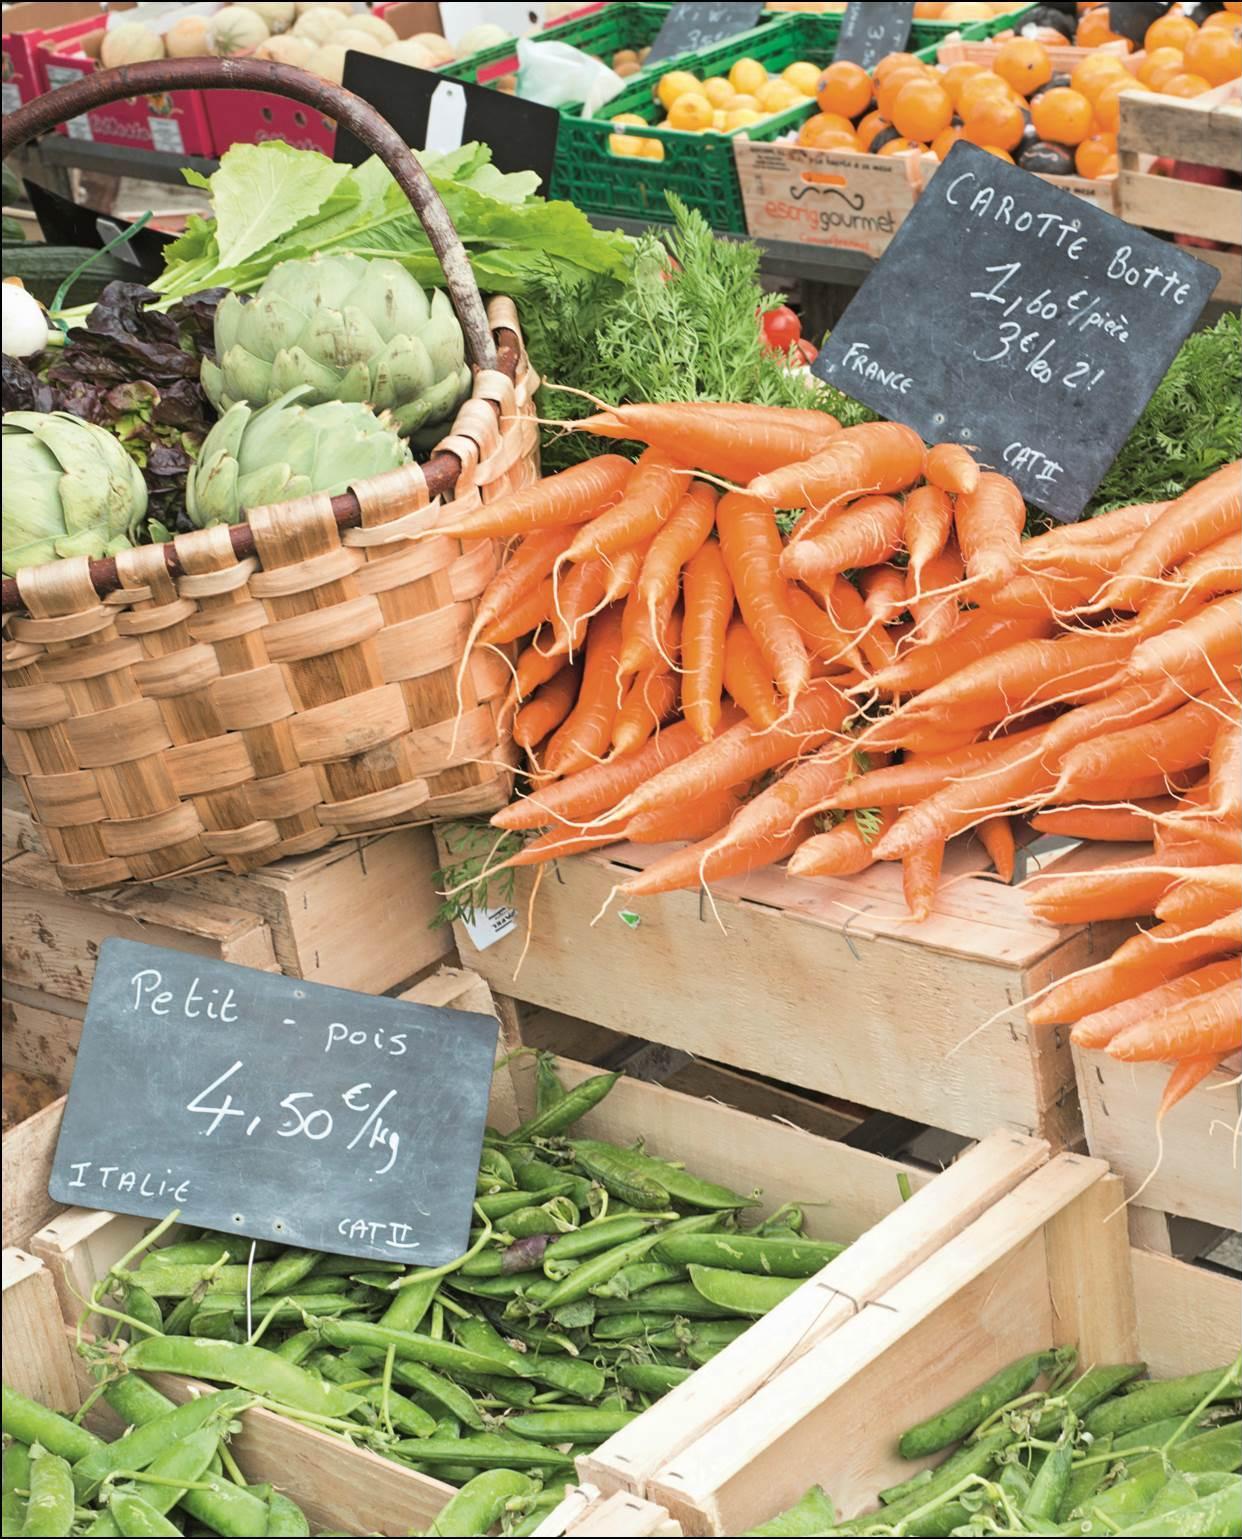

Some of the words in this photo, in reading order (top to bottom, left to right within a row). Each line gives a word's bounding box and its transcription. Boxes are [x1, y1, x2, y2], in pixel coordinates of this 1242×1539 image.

[946, 172, 1088, 260] CAROTTE
[842, 342, 914, 394] FRANCE
[1003, 442, 1046, 472] CAT
[131, 969, 238, 1022] Petit
[324, 1023, 407, 1054] pois
[338, 1218, 387, 1244] CAT
